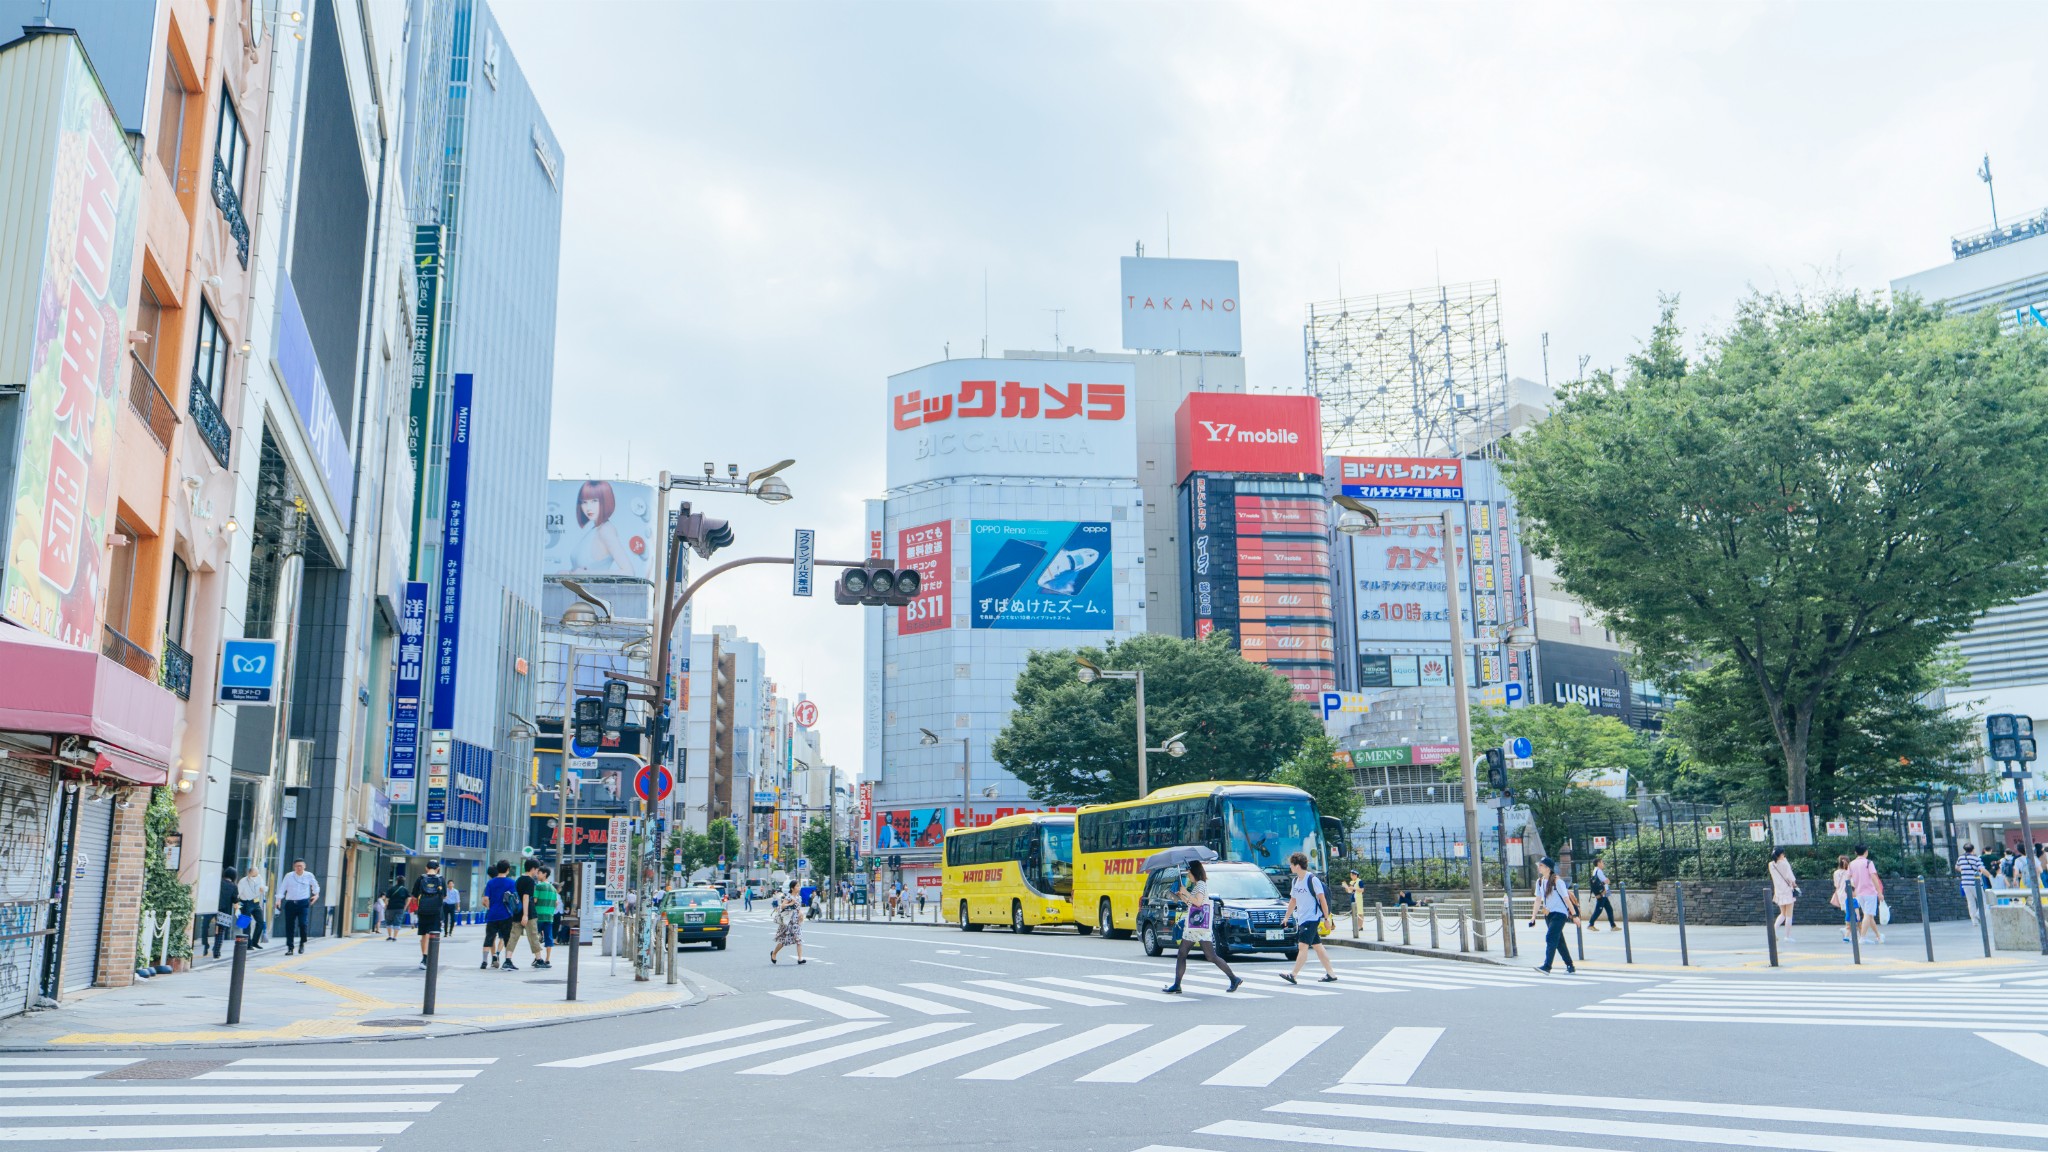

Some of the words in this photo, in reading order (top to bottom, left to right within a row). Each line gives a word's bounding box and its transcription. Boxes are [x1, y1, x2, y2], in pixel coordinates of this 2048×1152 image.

[414, 271, 429, 308] SMBC
[1128, 296, 1236, 312] TAKANO
[39, 131, 119, 594] 百果園
[411, 315, 428, 389] 三井住友銀行
[893, 380, 1126, 431] ビックカメラ
[309, 365, 336, 481] DHC
[458, 406, 468, 443] MIZUHO
[915, 434, 956, 460] BIC
[962, 432, 1095, 455] CAMERA
[1344, 463, 1457, 480] ヨドバシカメラ
[1360, 486, 1461, 497] マルチメディア新宿東口
[1197, 478, 1207, 530] ヨドバシカメラ
[449, 501, 461, 545] みずほ証券
[906, 527, 943, 543] いつでも
[976, 525, 1000, 534] OPPO
[1003, 526, 1026, 534] Reno
[906, 541, 943, 559] 無料放送
[797, 532, 810, 593] スクランブル交差点
[444, 559, 457, 623] みずほ信託銀行
[920, 581, 943, 592] すだけ
[1199, 582, 1211, 614] 総合館
[906, 595, 943, 621] BS11
[979, 598, 1107, 614] ずばぬけたズーム。
[1242, 595, 1262, 604] au
[1278, 594, 1302, 605] au
[8, 586, 91, 648] HYAKKAEN
[400, 599, 424, 681] 洋服の青山
[1244, 638, 1264, 646] au
[1278, 637, 1304, 648] au
[440, 637, 452, 684] みずほ銀行
[1505, 683, 1522, 706] P
[1555, 682, 1600, 707] LUSH
[1601, 687, 1621, 697] FRESH
[797, 703, 815, 723] 伊
[1324, 693, 1341, 720] P
[1365, 749, 1404, 760] MEN'S
[894, 816, 919, 829] キカホ
[617, 821, 628, 889] 歩道は歩行者が優先
[1104, 859, 1135, 875] HATO
[963, 870, 983, 882] HATO
[985, 869, 1003, 881] BUS
